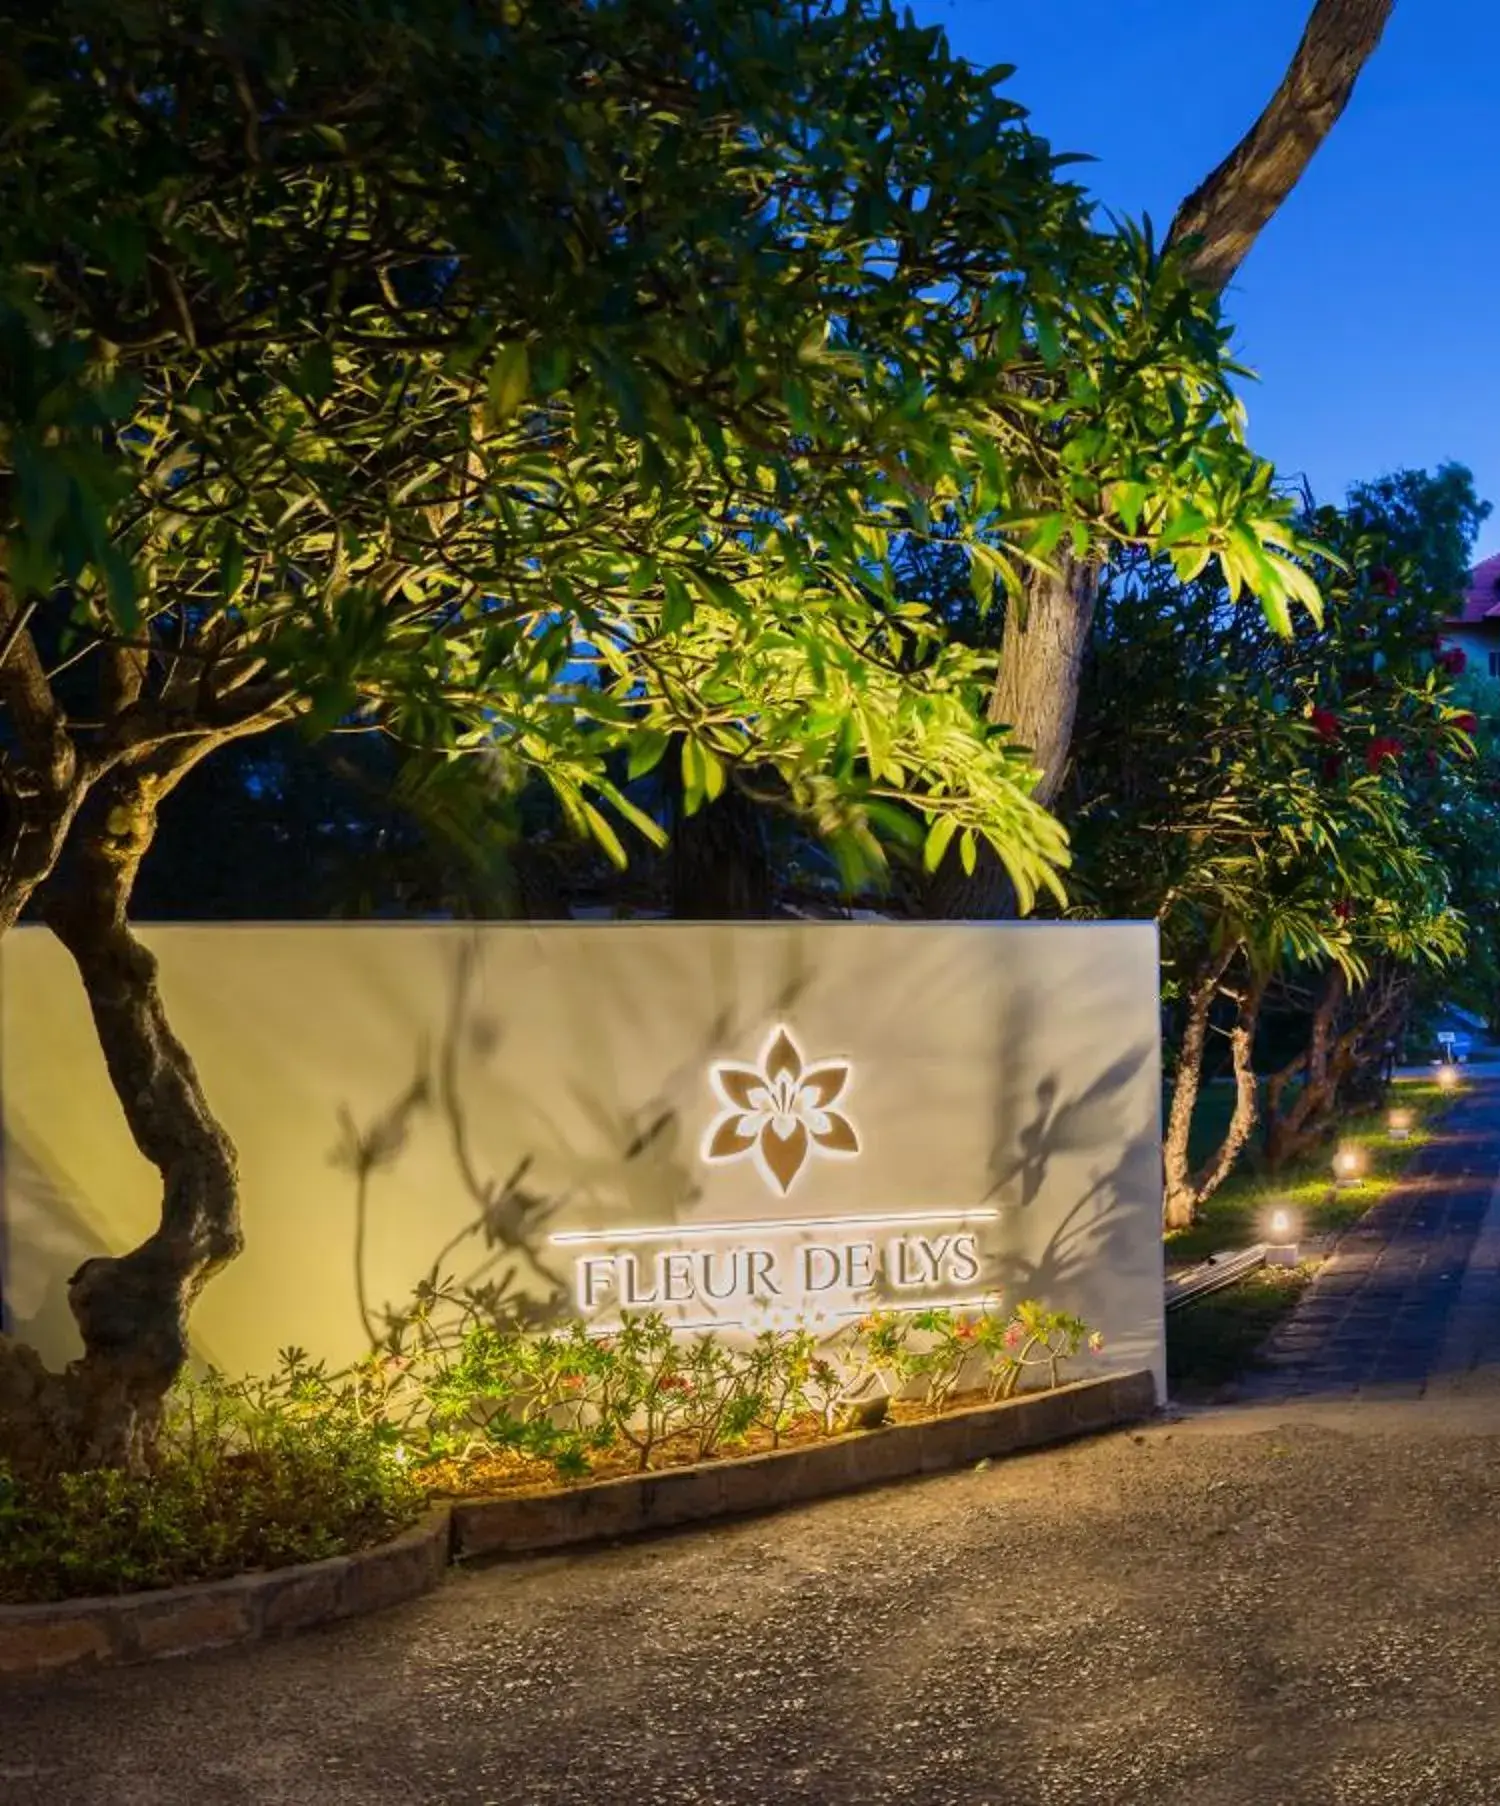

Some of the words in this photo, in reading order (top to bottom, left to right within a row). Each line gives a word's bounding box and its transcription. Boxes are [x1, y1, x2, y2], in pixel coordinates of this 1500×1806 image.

[582, 1250, 782, 1307] FLEUR
[803, 1243, 879, 1292] DE
[896, 1236, 980, 1286] LYS
